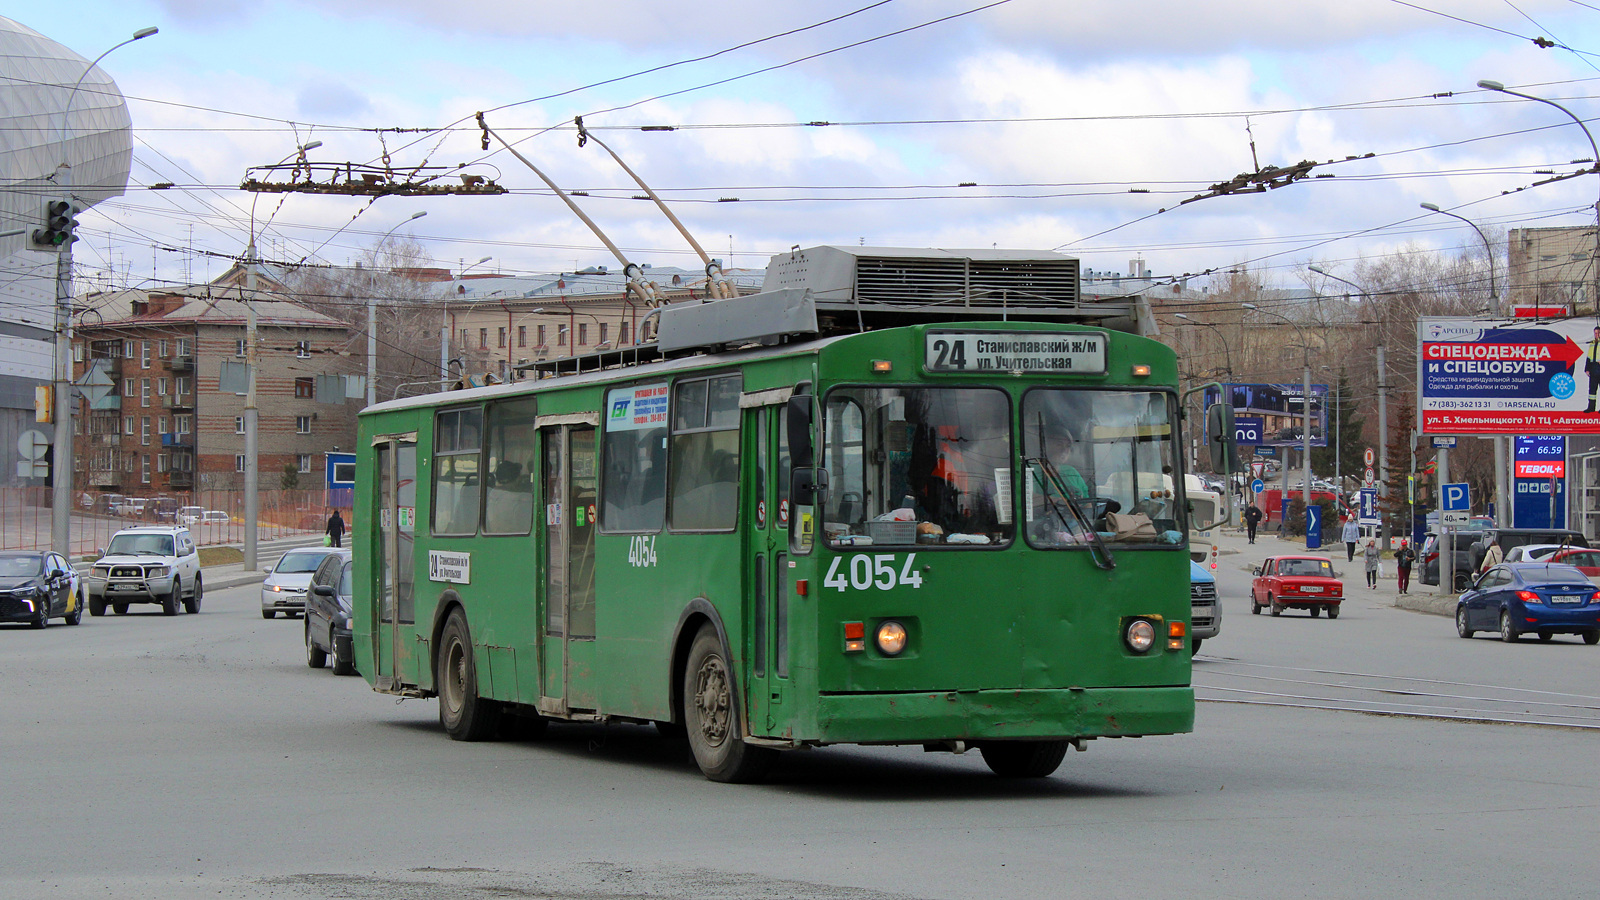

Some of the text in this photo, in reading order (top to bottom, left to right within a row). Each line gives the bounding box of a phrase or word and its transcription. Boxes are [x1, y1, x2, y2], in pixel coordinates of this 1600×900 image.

[977, 339, 1096, 354] Станиславский ж/м
[1428, 346, 1550, 360] СПЕЦОДЕЖДА
[934, 340, 966, 369] 24
[977, 356, 1072, 369] ул. Учительская
[1428, 361, 1546, 375] и СПЕЦОБУВЬ
[1525, 416, 1536, 424] 1/1
[1538, 417, 1551, 425] ТЦ
[1538, 446, 1562, 454] 66.59
[628, 536, 657, 567] 4054
[431, 554, 437, 577] 24
[824, 553, 922, 592] 4054
